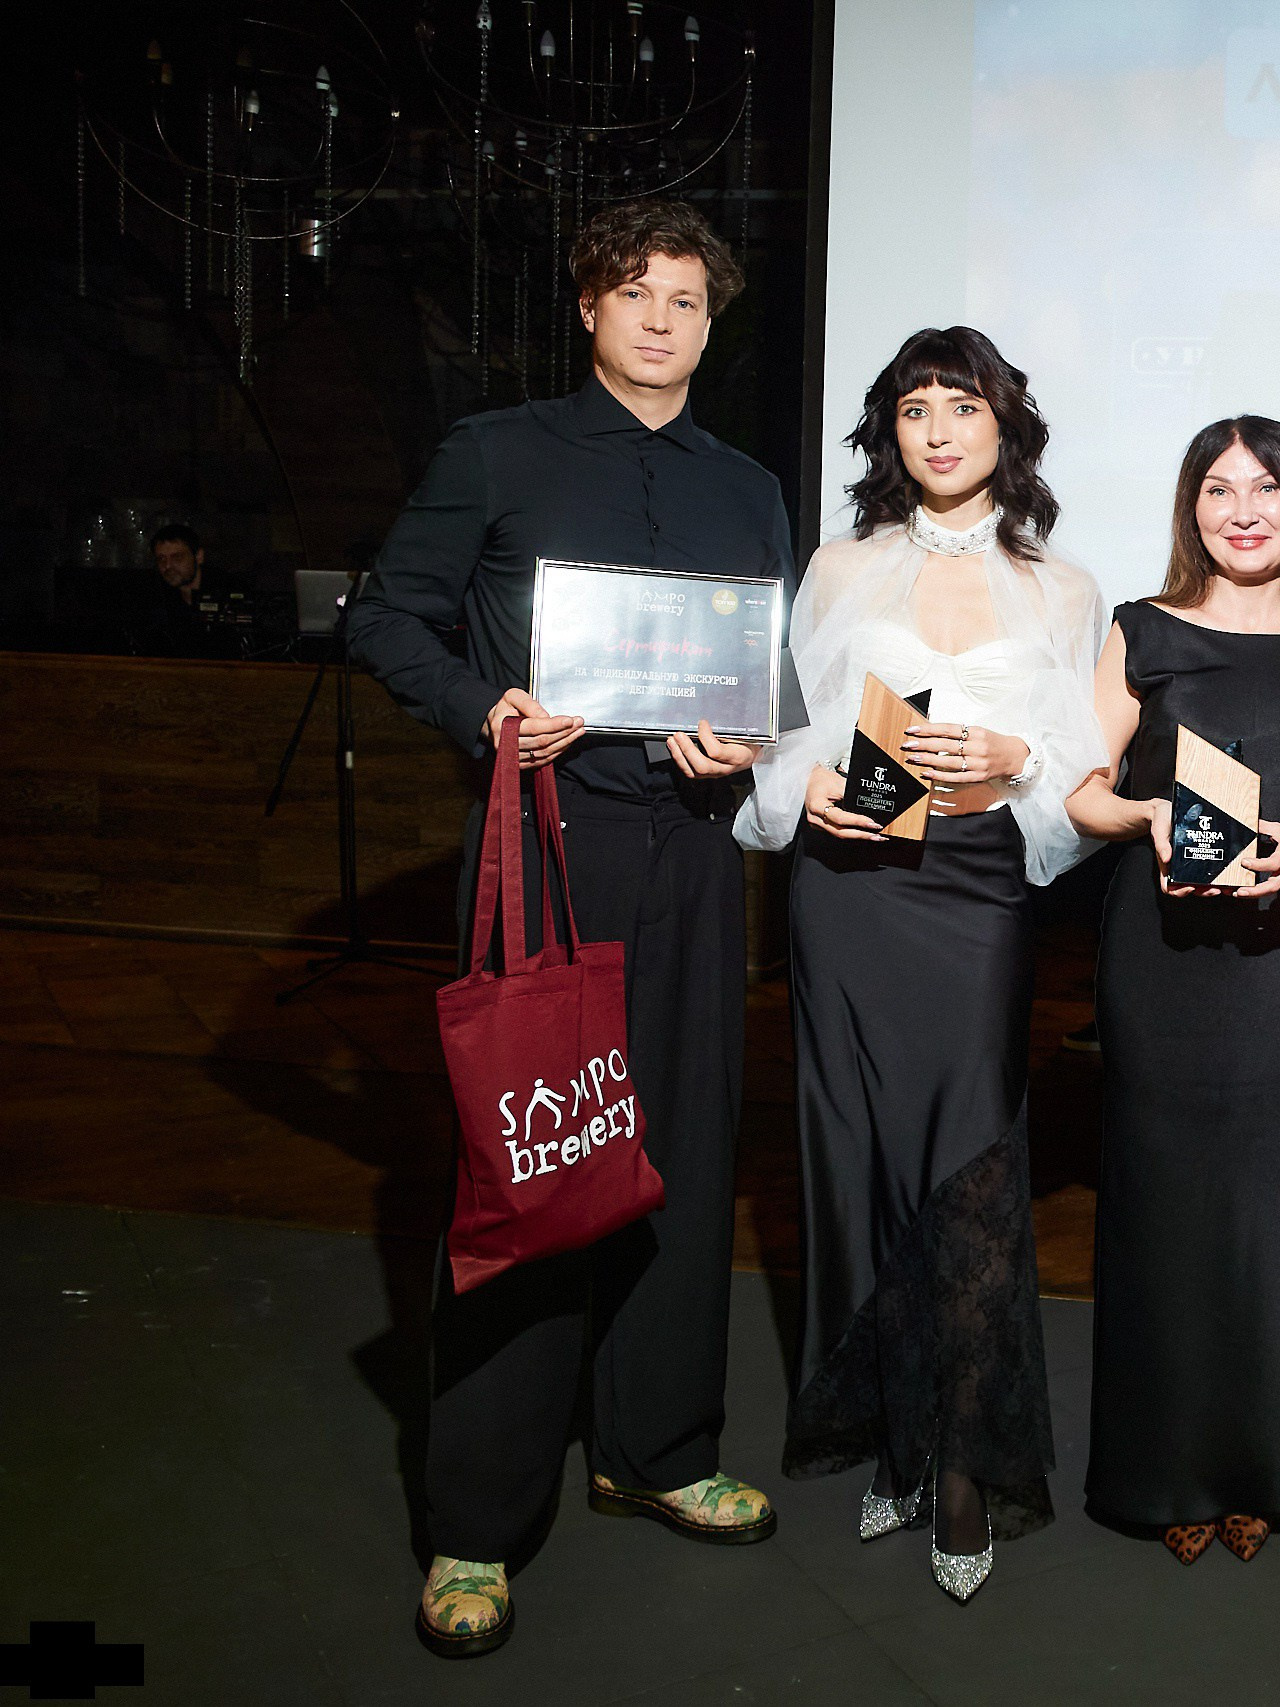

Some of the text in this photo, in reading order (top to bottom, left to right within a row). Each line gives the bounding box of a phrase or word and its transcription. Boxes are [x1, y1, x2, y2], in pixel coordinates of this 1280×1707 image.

[636, 602, 686, 617] brewery
[574, 666, 739, 686] НА ИНДИВИДУАЛЬНУЮ ЭКСКУРСИЮ
[629, 685, 697, 698] ДЕГУСТАЦИЕЙ
[860, 778, 897, 793] TUNDRA
[1185, 830, 1225, 841] TUNDRA
